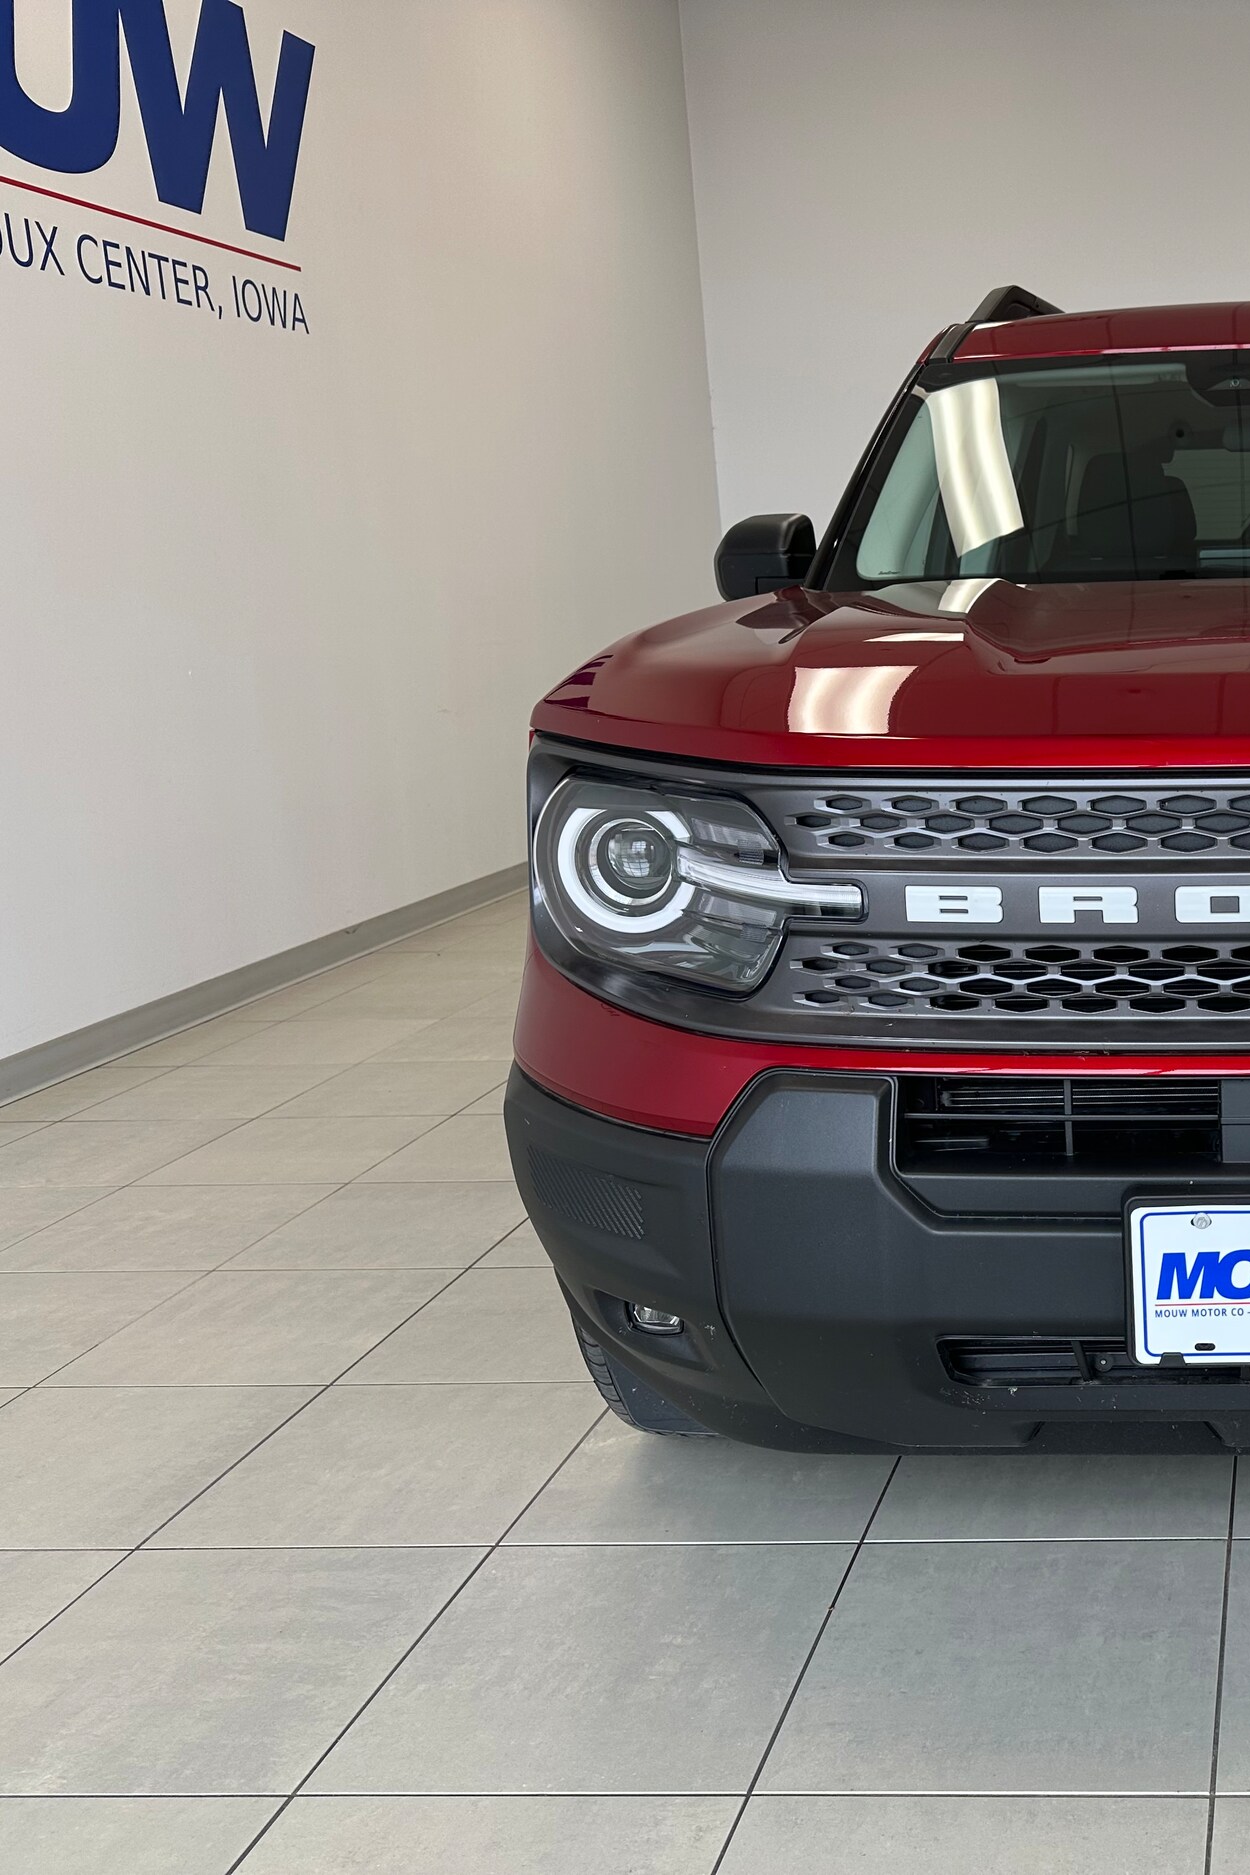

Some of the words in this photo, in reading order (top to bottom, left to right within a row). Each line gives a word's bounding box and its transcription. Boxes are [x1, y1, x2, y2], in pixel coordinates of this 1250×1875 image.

[0, 213, 65, 276] UX
[76, 234, 223, 319] CENTER,
[232, 276, 310, 334] IOWA
[1154, 1309, 1188, 1318] MOUW
[1191, 1308, 1227, 1317] MOTOR
[1231, 1307, 1244, 1317] CO
